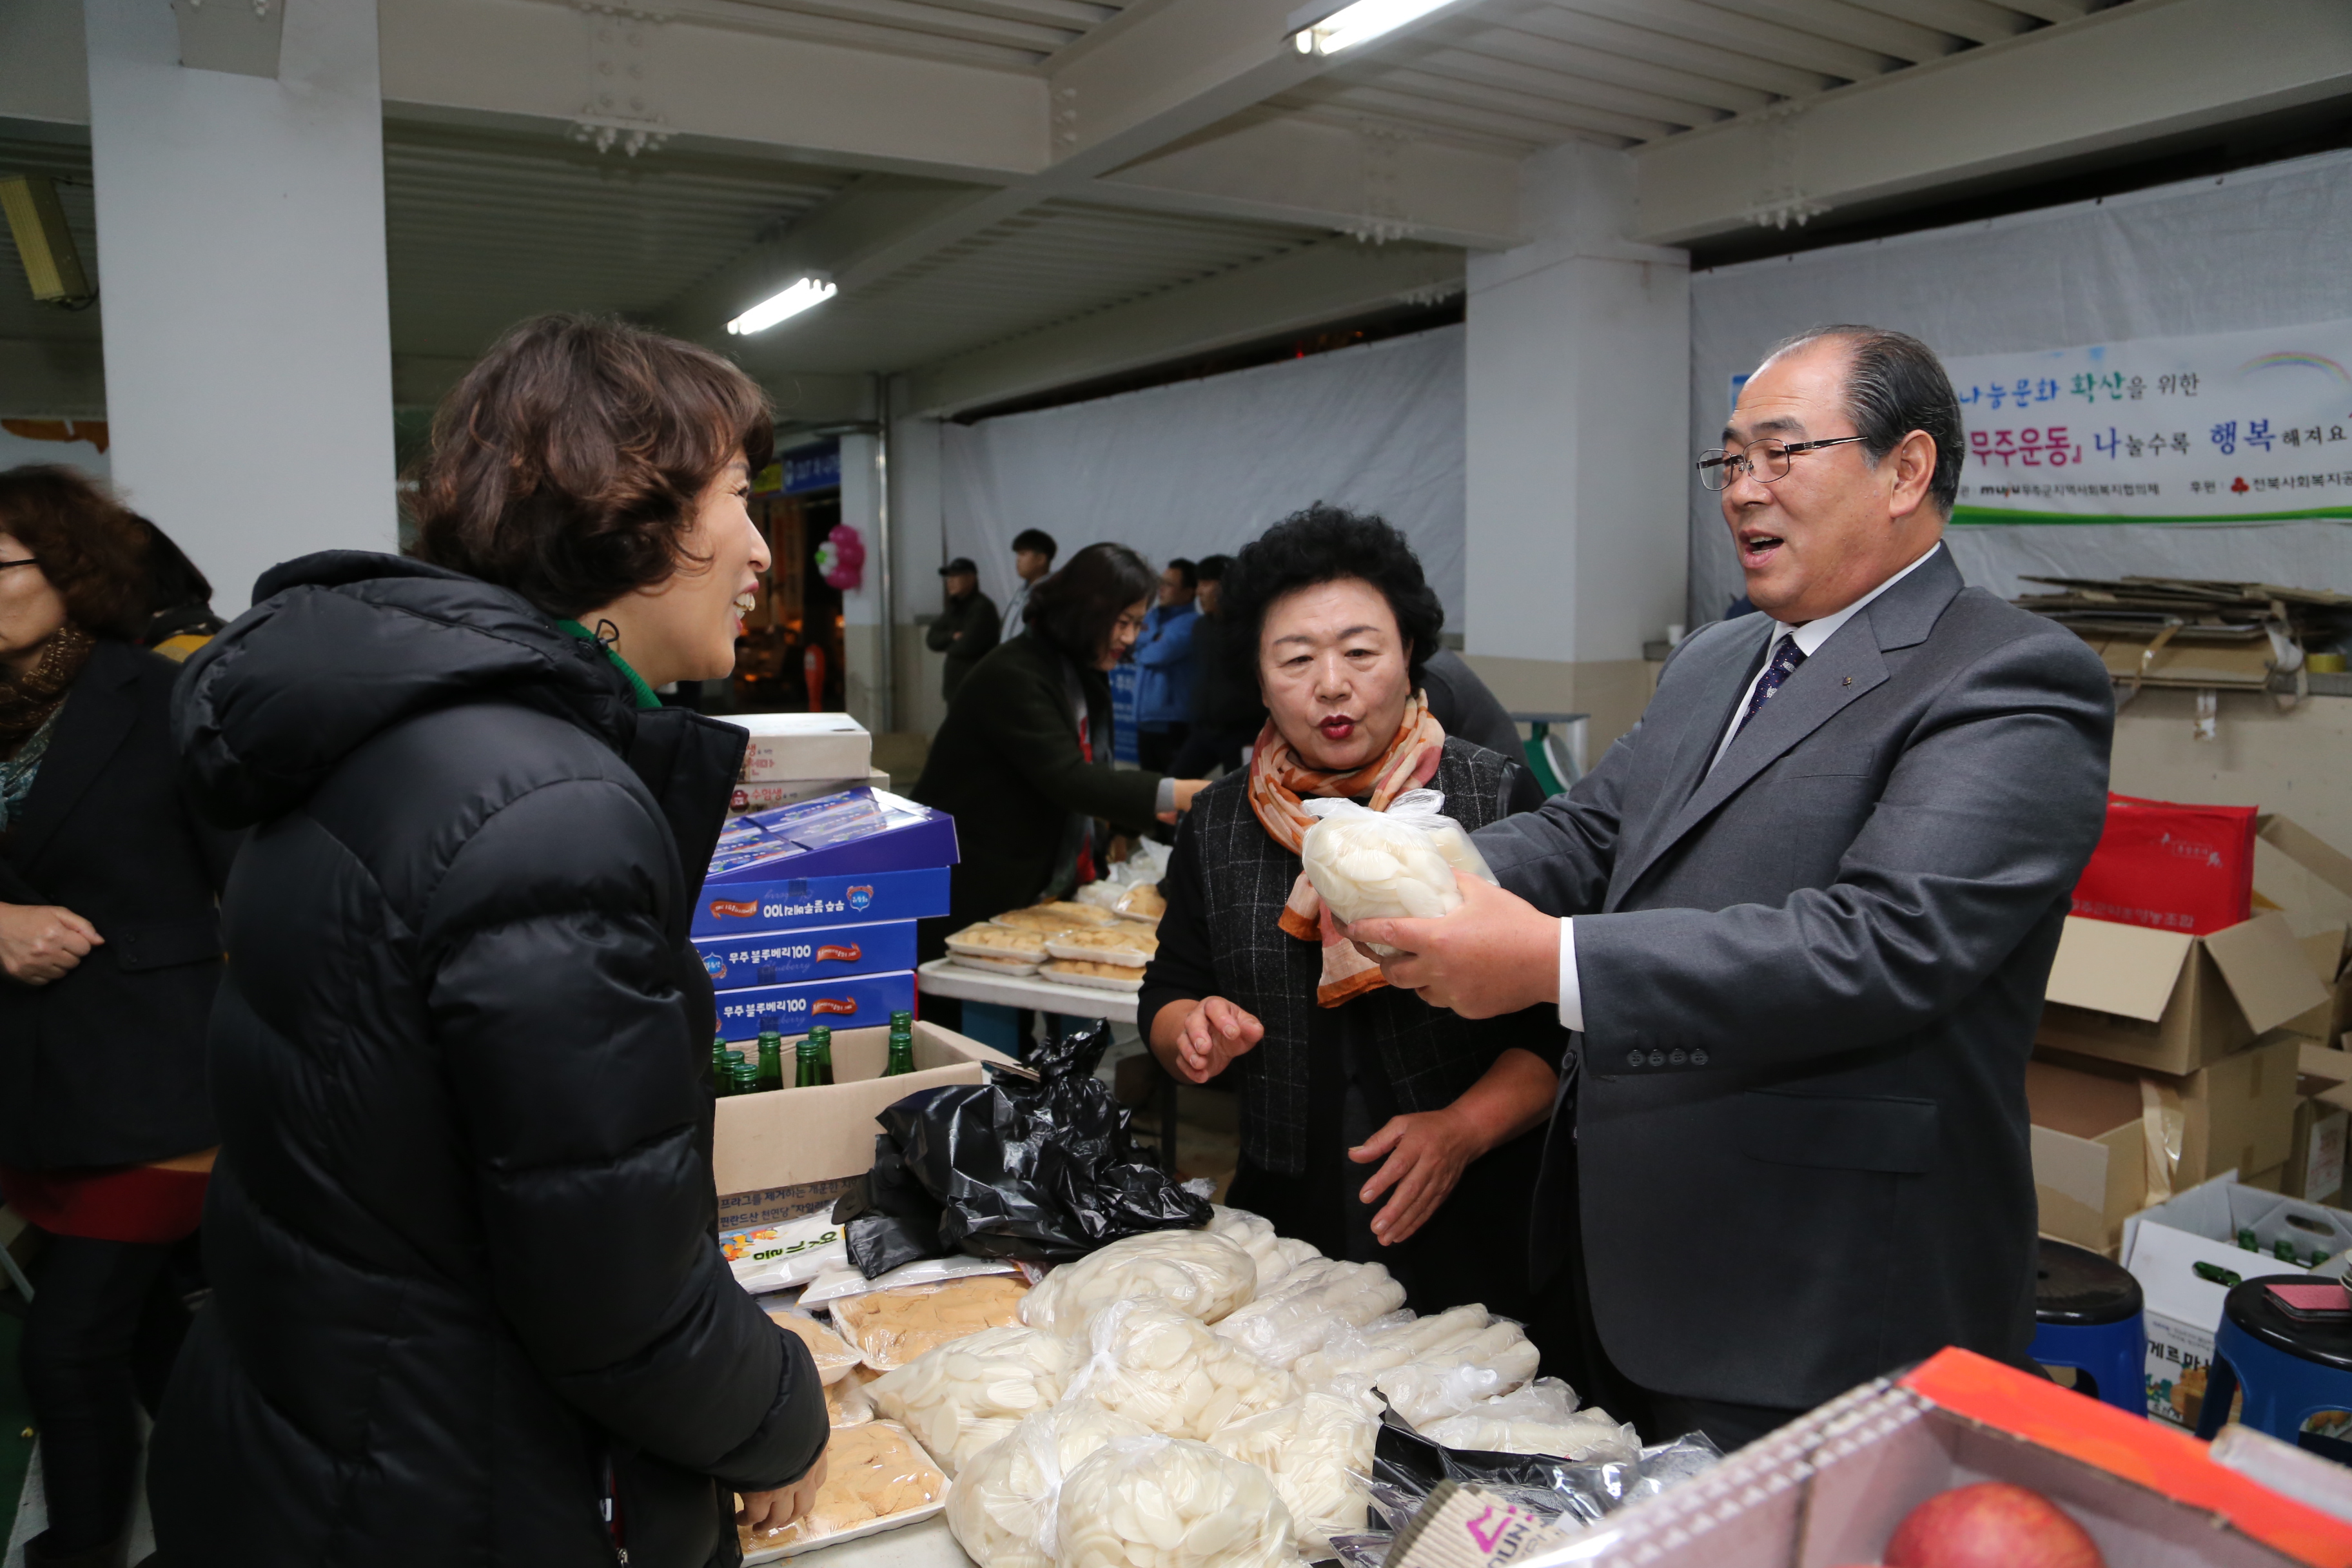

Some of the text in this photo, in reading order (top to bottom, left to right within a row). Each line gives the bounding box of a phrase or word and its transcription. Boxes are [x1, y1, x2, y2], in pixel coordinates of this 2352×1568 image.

[2070, 371, 2148, 404] 확산을
[2158, 372, 2199, 397] 위한
[763, 899, 823, 918] 블루베리100
[826, 900, 845, 912] 무주
[729, 951, 749, 964] 무주
[750, 945, 811, 964] 블루베리100
[723, 1004, 744, 1017] 무주
[745, 999, 806, 1017] 블루베리100
[720, 1193, 762, 1210] 프라그를
[764, 1187, 805, 1201] 제거하는
[808, 1181, 838, 1195] 개운한
[720, 1212, 759, 1228] 핀란드산
[761, 1207, 789, 1222] 천연당
